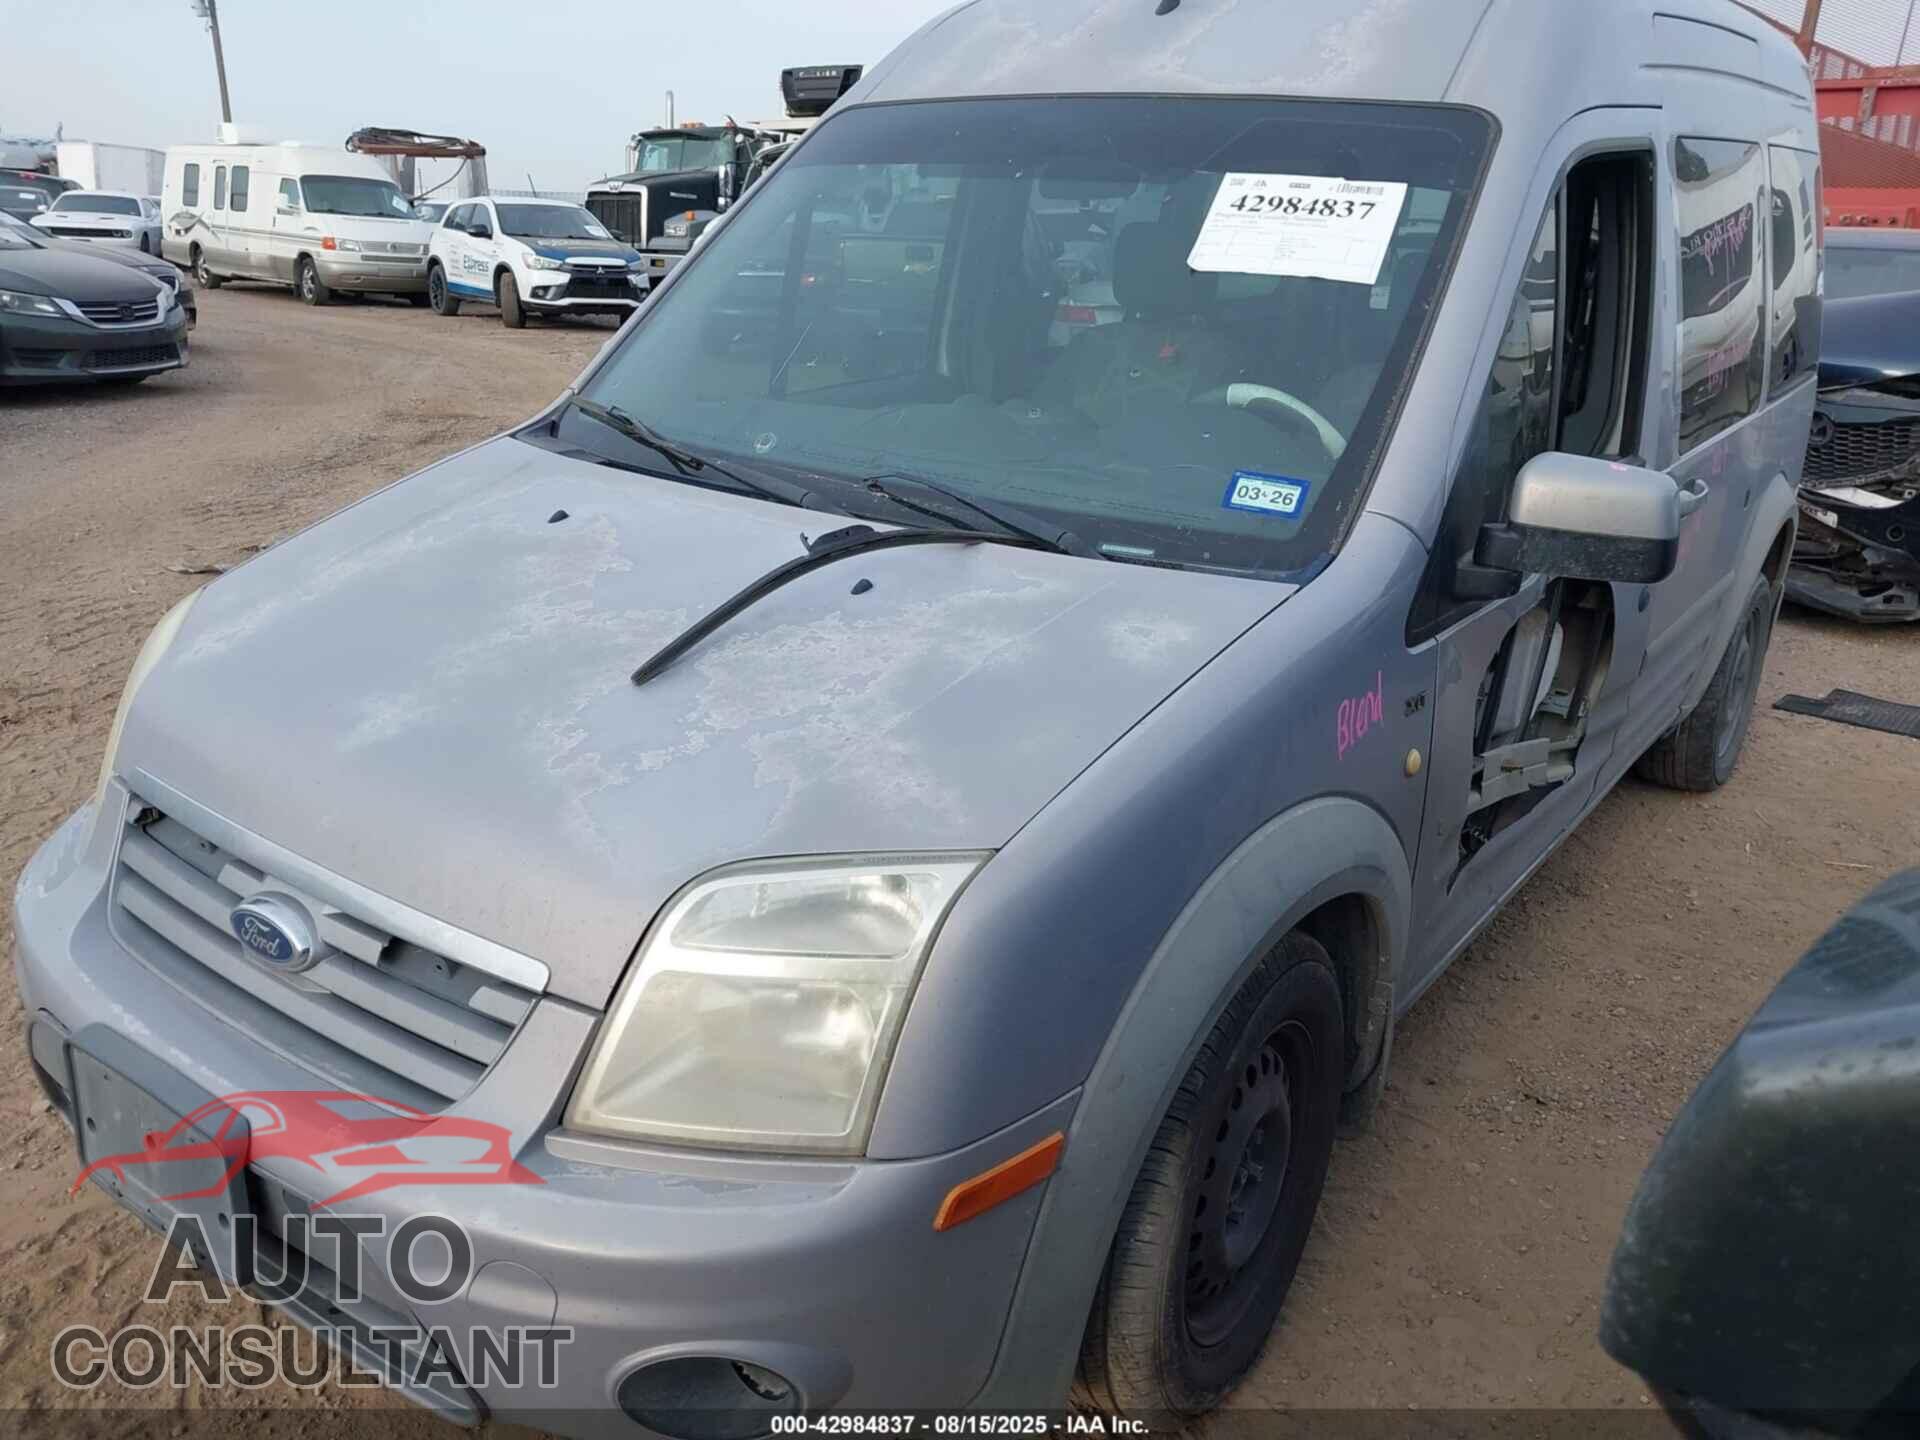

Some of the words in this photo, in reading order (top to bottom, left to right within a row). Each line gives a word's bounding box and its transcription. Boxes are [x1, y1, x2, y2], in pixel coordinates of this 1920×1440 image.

[1229, 193, 1377, 222] 42984837
[1236, 485, 1262, 501] 03
[1269, 490, 1296, 506] 26
[240, 916, 281, 956] Ford
